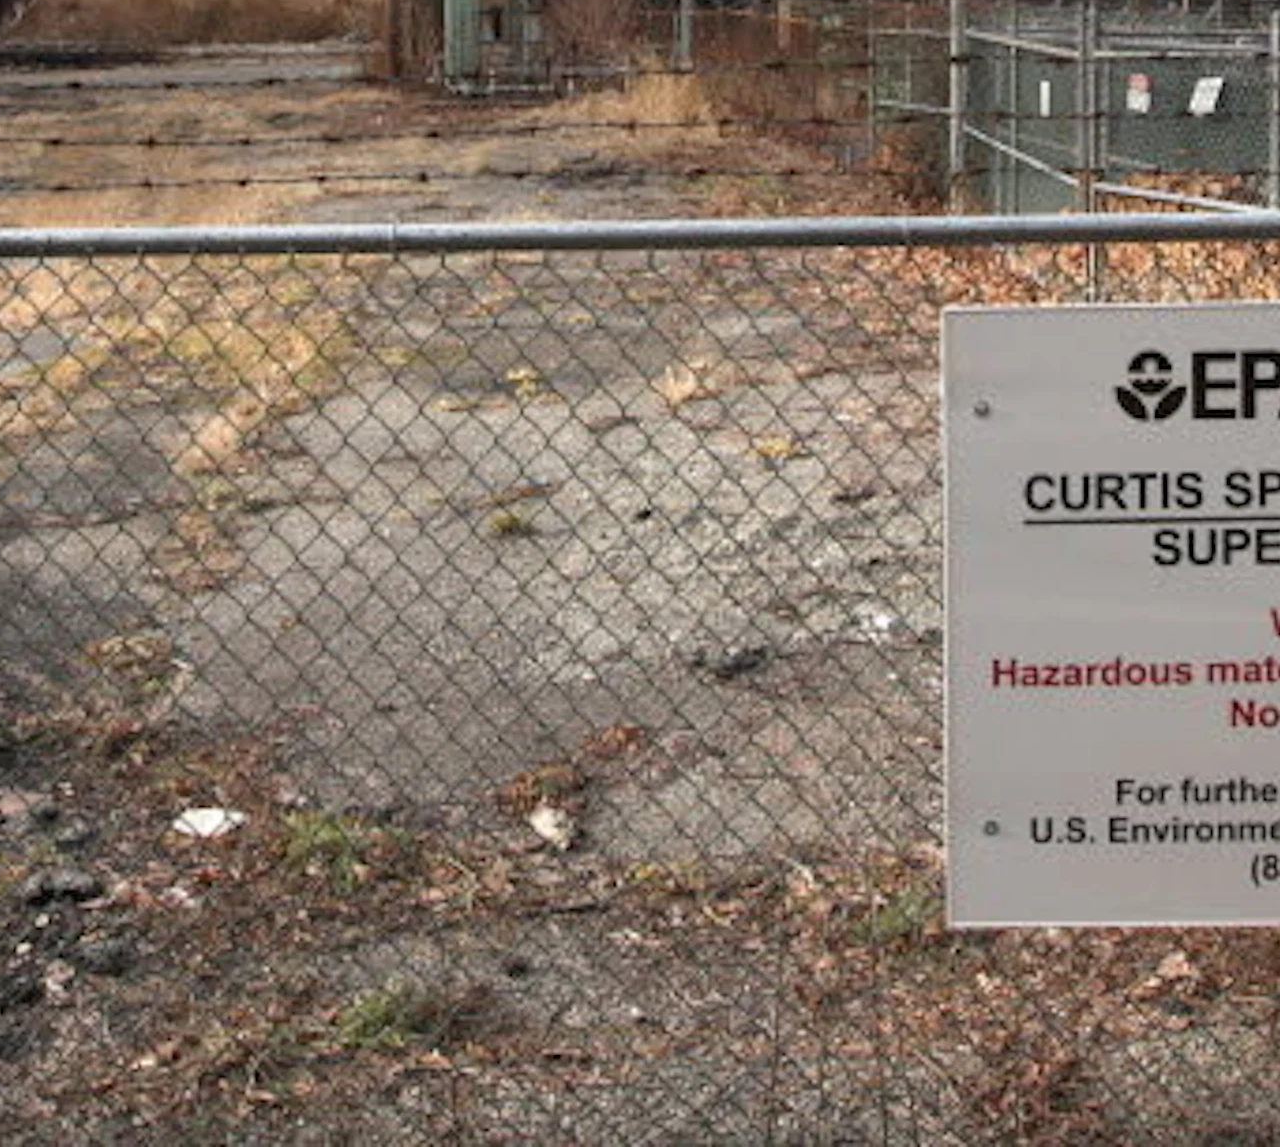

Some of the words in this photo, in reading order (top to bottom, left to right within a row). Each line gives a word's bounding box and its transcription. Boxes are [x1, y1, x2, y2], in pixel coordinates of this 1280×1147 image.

[1023, 472, 1204, 513] CURTIS
[992, 656, 1194, 689] Hazardous
[1230, 698, 1280, 728] No
[1116, 778, 1173, 806] For
[1030, 816, 1096, 844] U.S.
